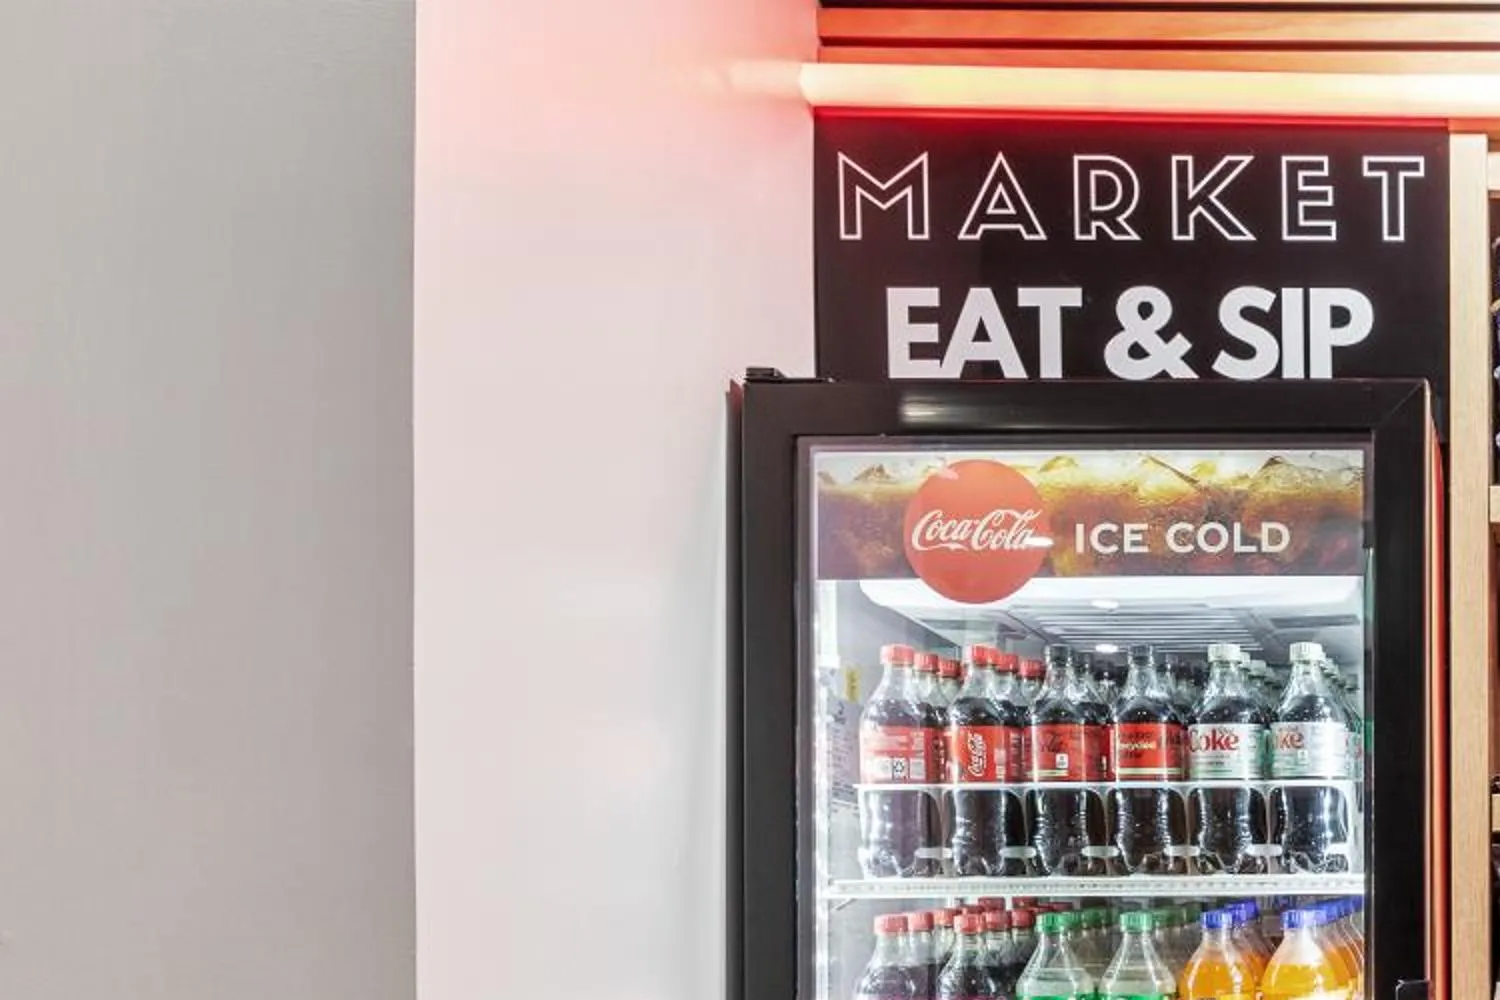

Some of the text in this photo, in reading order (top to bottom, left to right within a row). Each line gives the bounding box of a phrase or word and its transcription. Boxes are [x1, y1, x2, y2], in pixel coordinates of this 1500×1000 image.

[838, 152, 1426, 242] MARKET
[886, 285, 1375, 380] EAT & SIP
[911, 508, 1056, 553] Coca-Cola
[1076, 521, 1291, 554] ICE COLD
